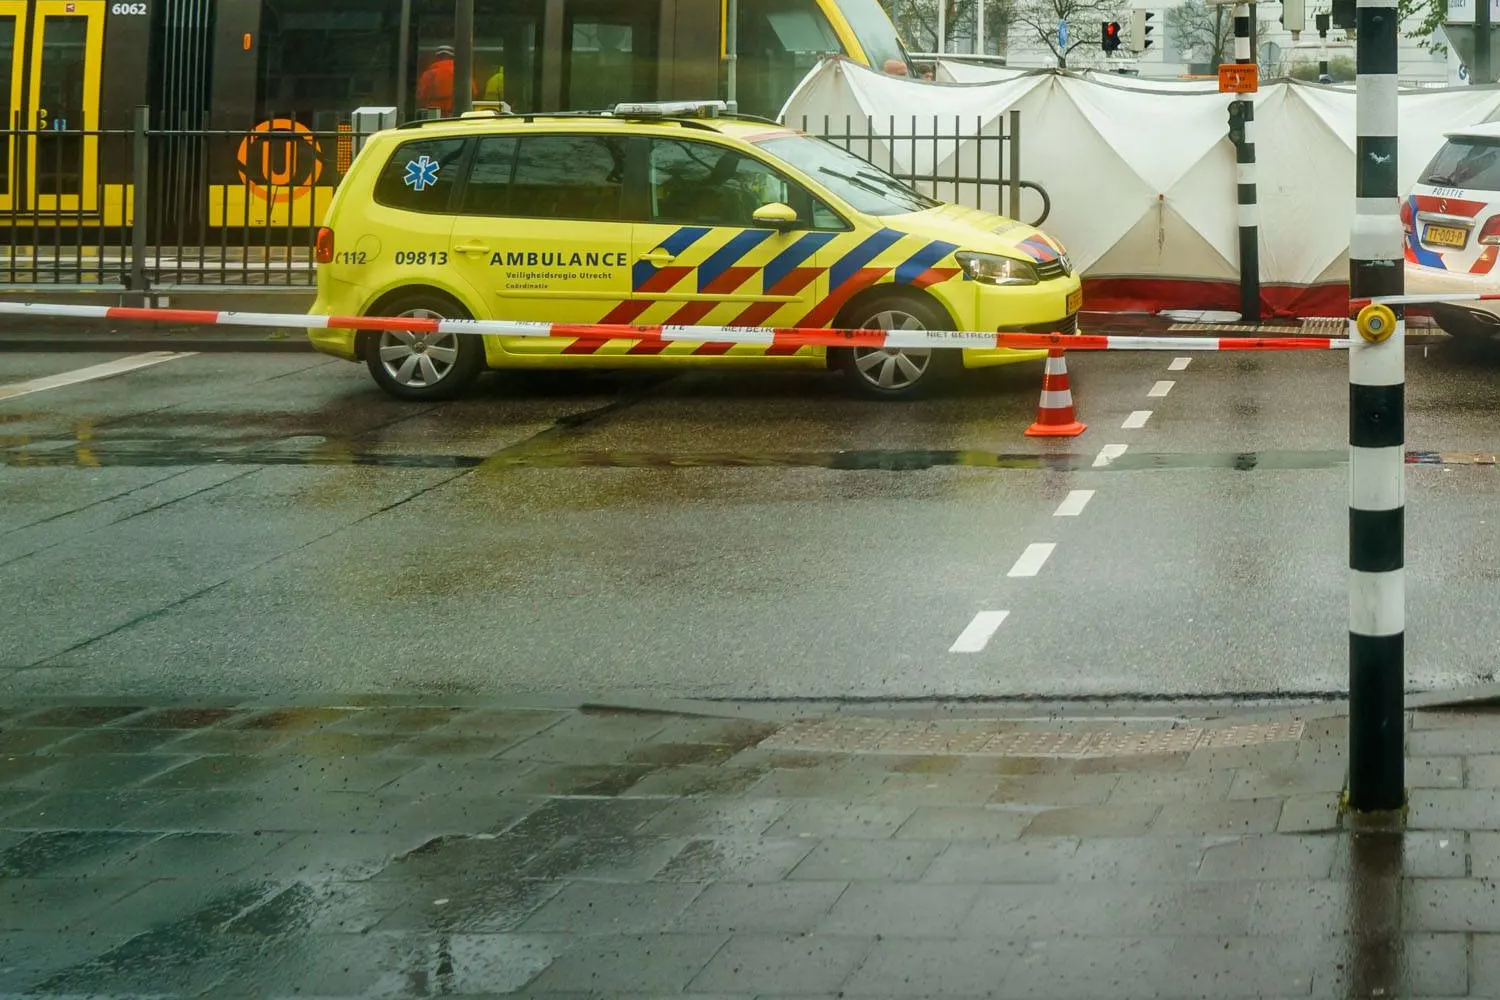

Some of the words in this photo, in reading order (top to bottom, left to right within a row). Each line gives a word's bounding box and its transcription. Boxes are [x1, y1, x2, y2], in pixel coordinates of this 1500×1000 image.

[112, 3, 147, 15] 6062
[1432, 187, 1465, 199] POLITIE
[1429, 227, 1463, 244] TT-003-P
[343, 251, 367, 265] 112
[395, 251, 449, 265] 09813
[489, 252, 628, 266] AMBULANCE
[506, 271, 577, 280] Veiligheidsregio
